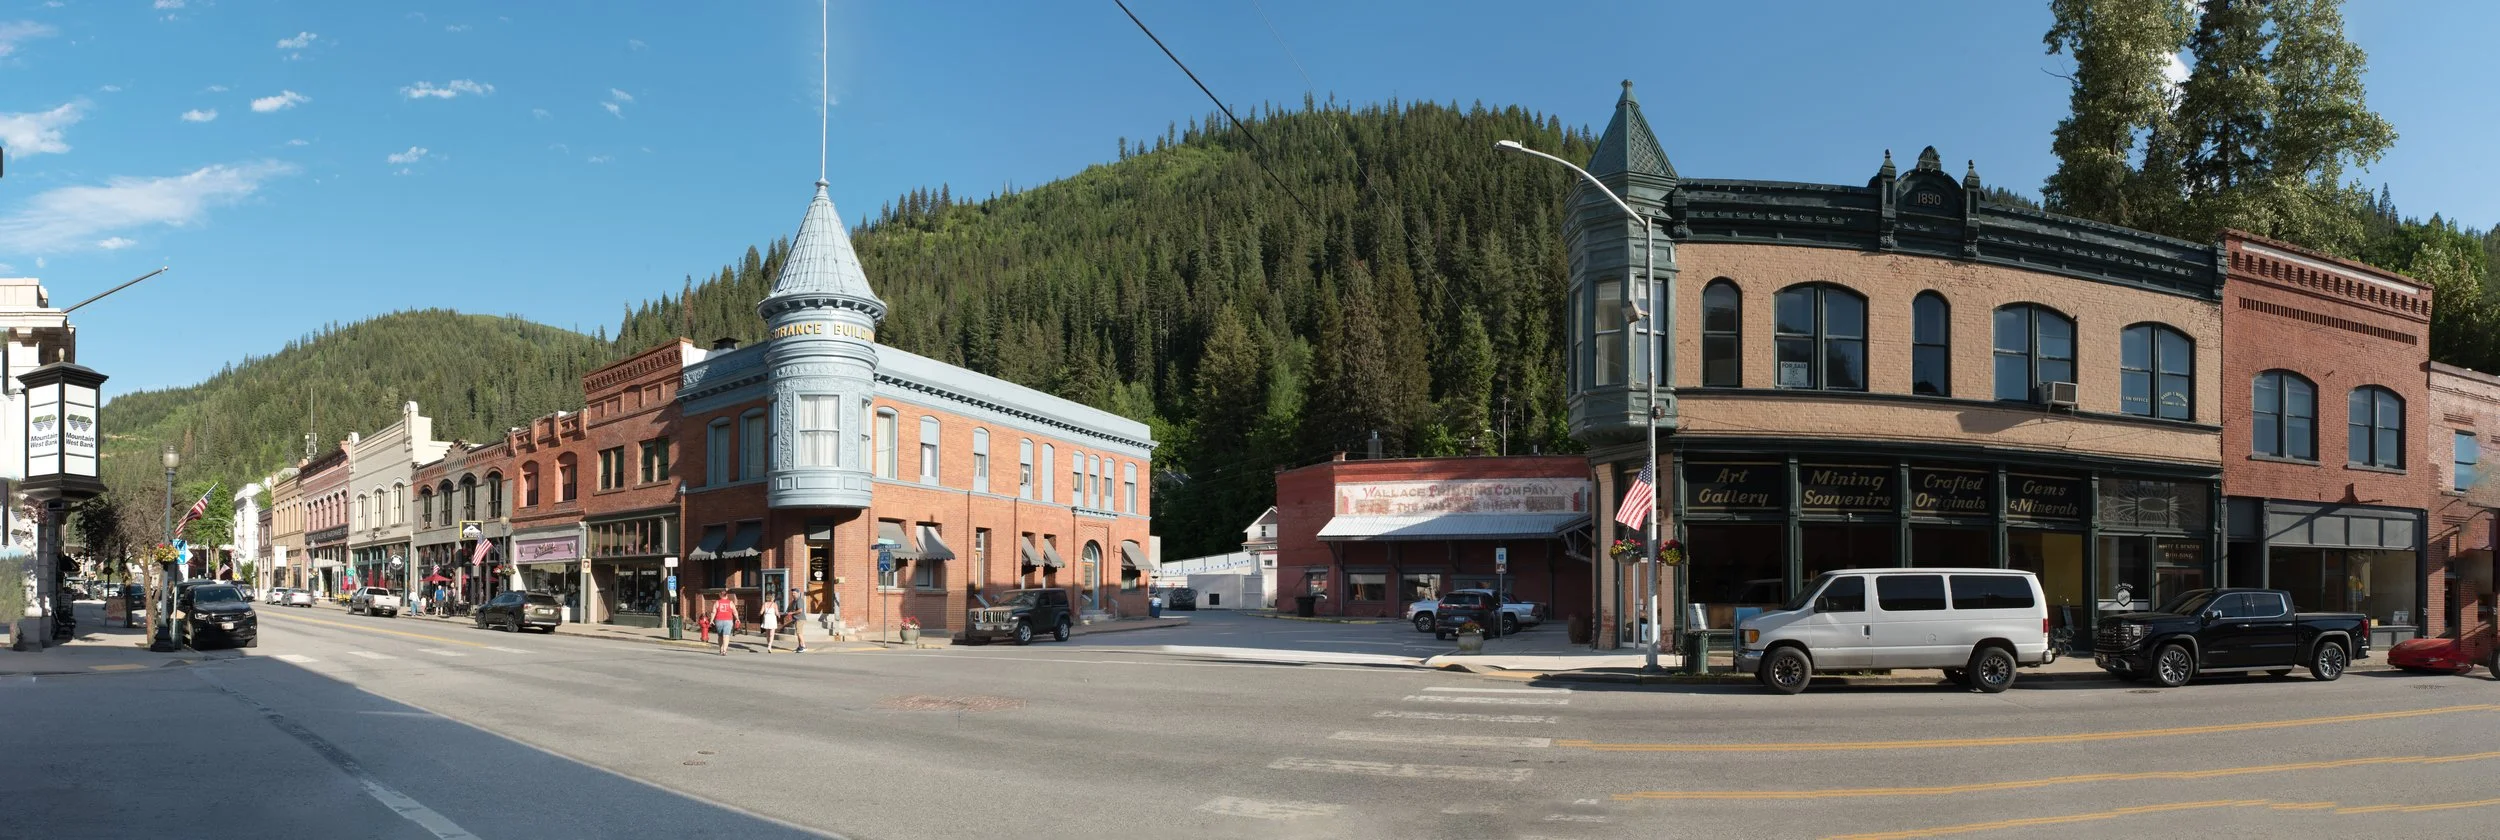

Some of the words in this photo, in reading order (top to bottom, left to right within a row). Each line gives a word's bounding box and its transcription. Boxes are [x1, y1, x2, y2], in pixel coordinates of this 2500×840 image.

[1917, 193, 1941, 206] 1890
[30, 433, 58, 441] Mountain
[66, 432, 94, 441] Mountain
[66, 439, 79, 447] West
[1716, 468, 1749, 483] Art
[1811, 470, 1885, 491] Mining
[1495, 484, 1557, 495] COMPANY
[1924, 473, 1984, 494] Crafted
[2022, 480, 2067, 496] Gems
[1698, 488, 1769, 507] Gallery
[1803, 489, 1892, 507] Souvenirs
[1915, 492, 1986, 511] Originals
